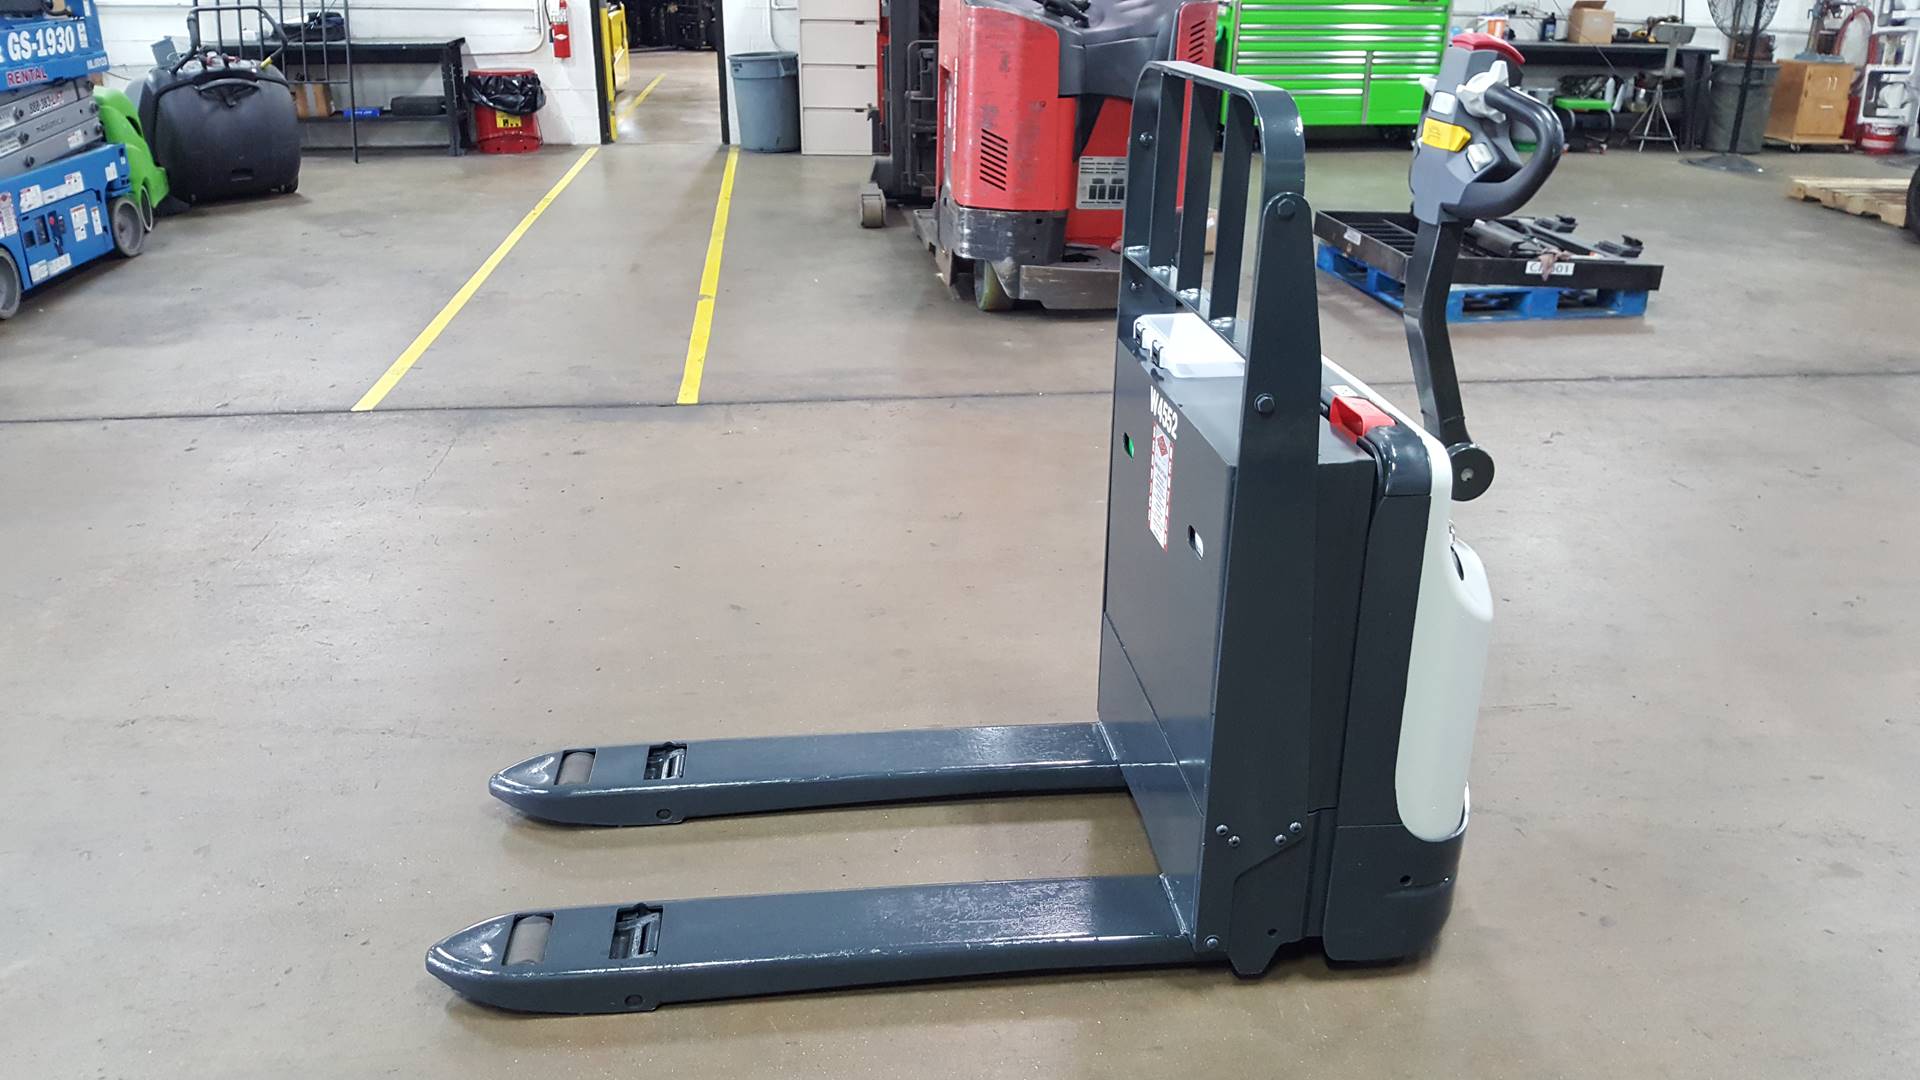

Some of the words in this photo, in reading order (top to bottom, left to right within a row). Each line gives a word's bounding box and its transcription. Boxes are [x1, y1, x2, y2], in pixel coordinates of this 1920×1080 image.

[8, 25, 75, 61] GS-1930
[7, 68, 48, 87] RENTAL
[1530, 262, 1569, 273] C01
[1150, 384, 1178, 440] W4552
